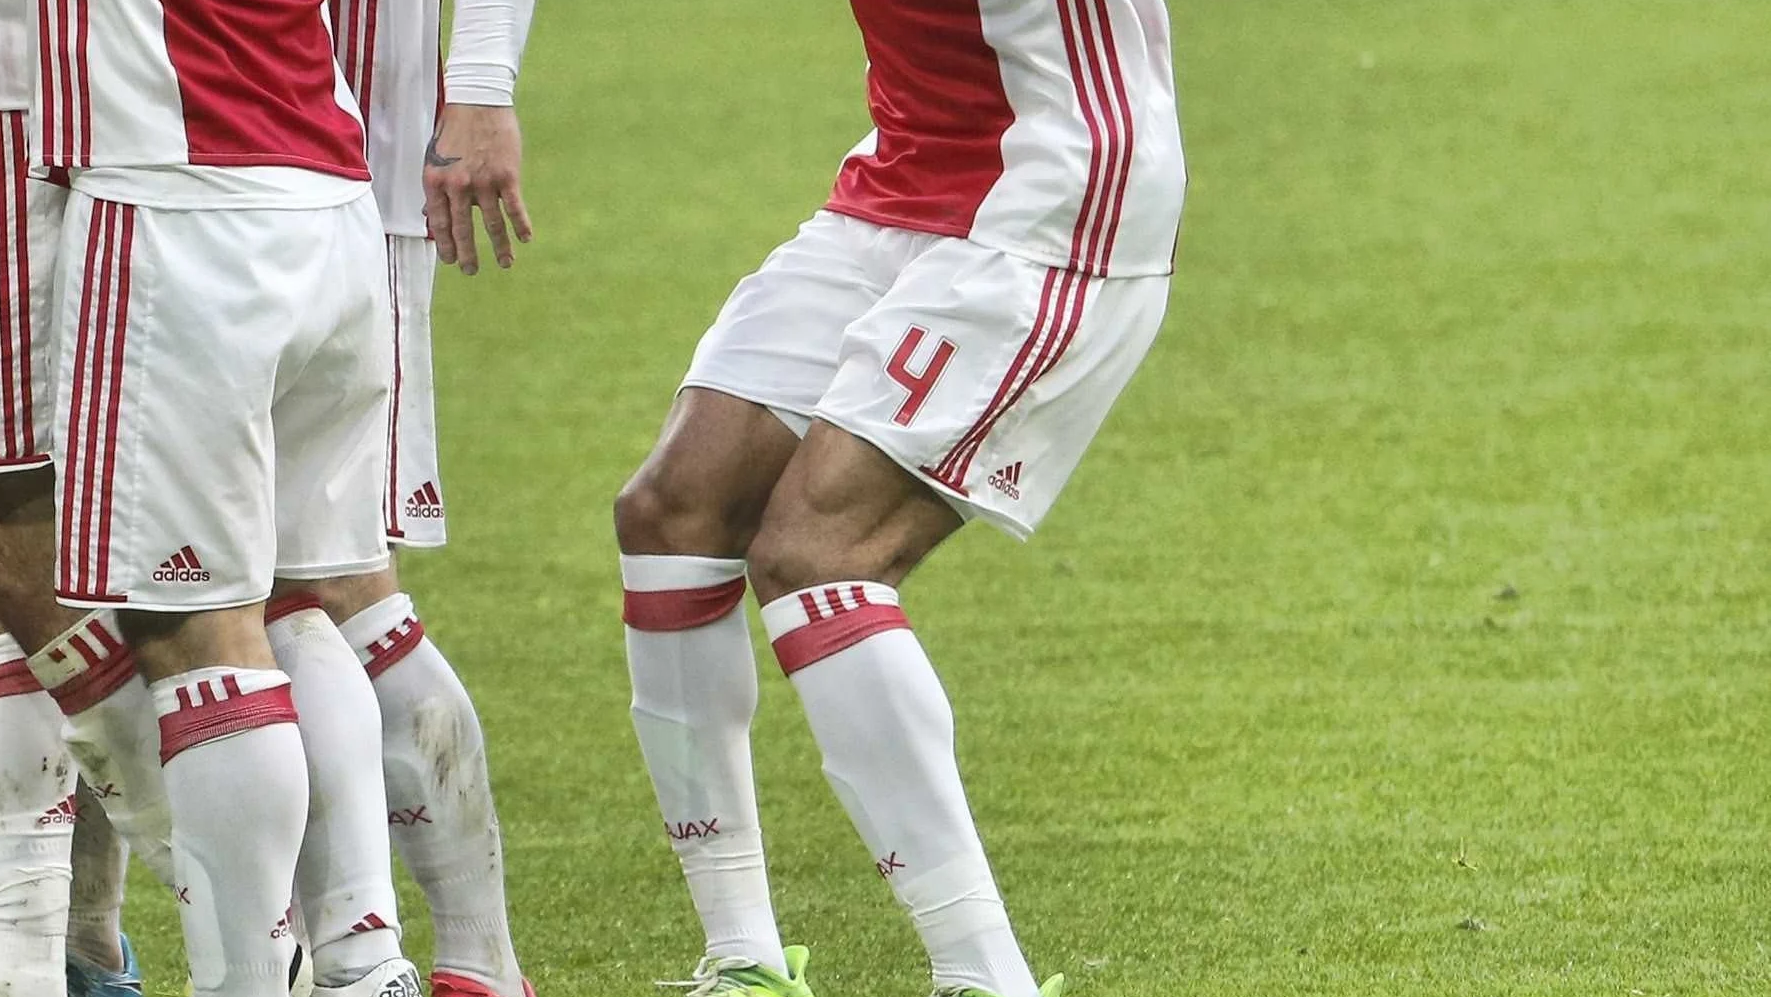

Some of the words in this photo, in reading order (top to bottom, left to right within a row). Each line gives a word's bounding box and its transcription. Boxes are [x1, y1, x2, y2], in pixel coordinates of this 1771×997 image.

[884, 323, 960, 429] 4
[988, 474, 1020, 500] adidas
[152, 567, 211, 582] adidas
